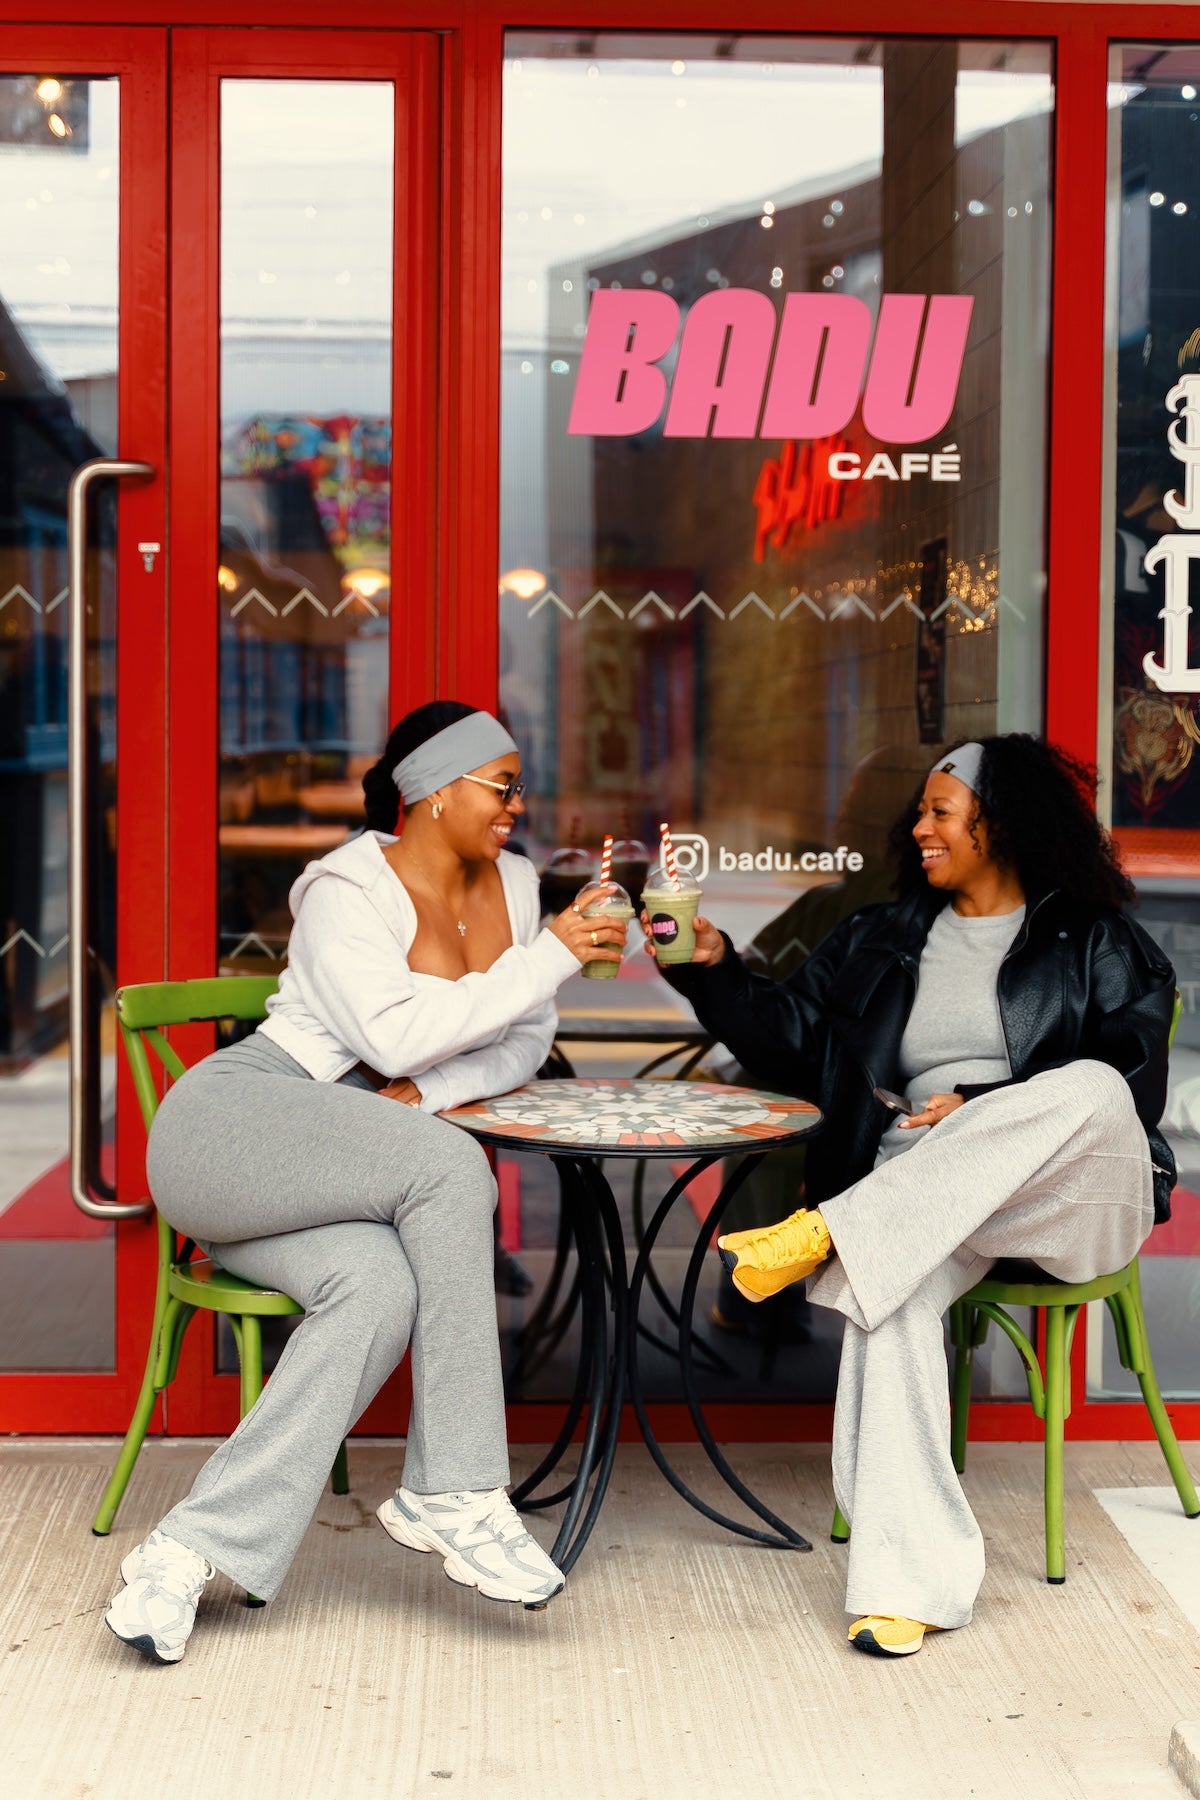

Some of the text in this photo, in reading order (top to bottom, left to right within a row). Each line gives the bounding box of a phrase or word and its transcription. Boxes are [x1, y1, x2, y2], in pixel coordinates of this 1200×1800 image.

[568, 288, 975, 444] BADU
[828, 443, 961, 481] CAFÉ
[719, 846, 864, 872] badu.cafe
